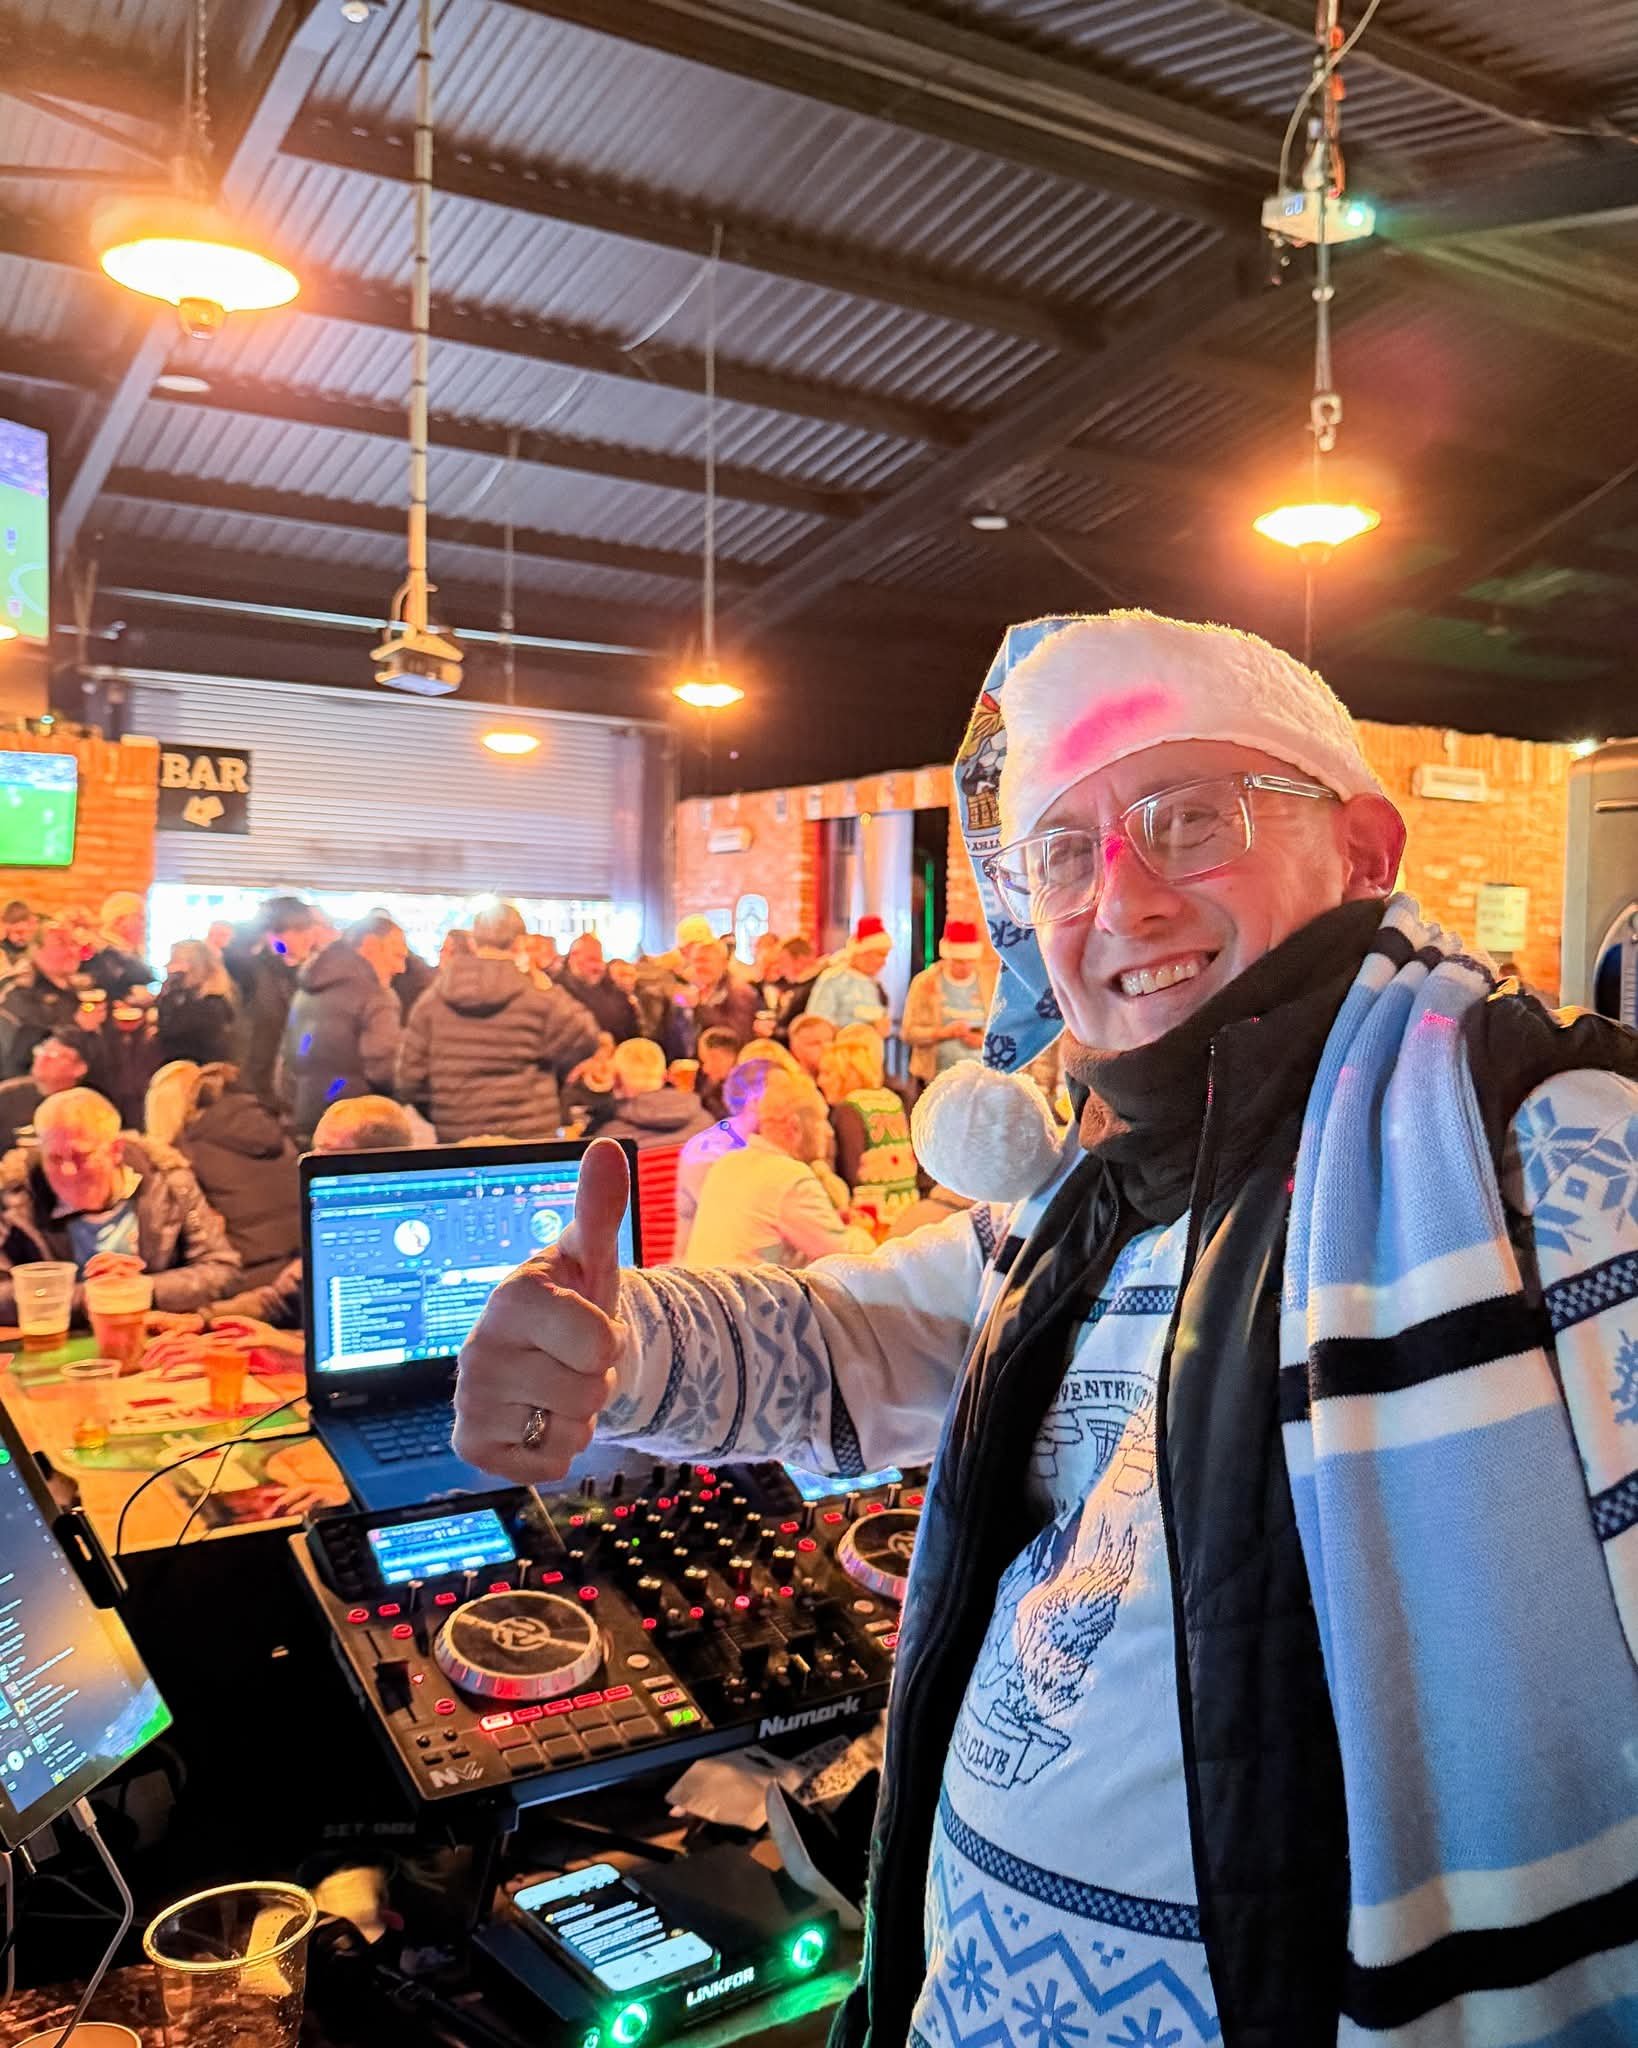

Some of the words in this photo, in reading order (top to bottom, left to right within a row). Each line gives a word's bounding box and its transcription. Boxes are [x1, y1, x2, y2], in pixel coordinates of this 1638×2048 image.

[159, 751, 249, 793] BAR
[1055, 1380, 1134, 1402] VENTRY
[758, 1695, 861, 1739] Numark
[967, 1736, 1011, 1775] CLUB
[686, 1966, 755, 2008] LINKFOR
